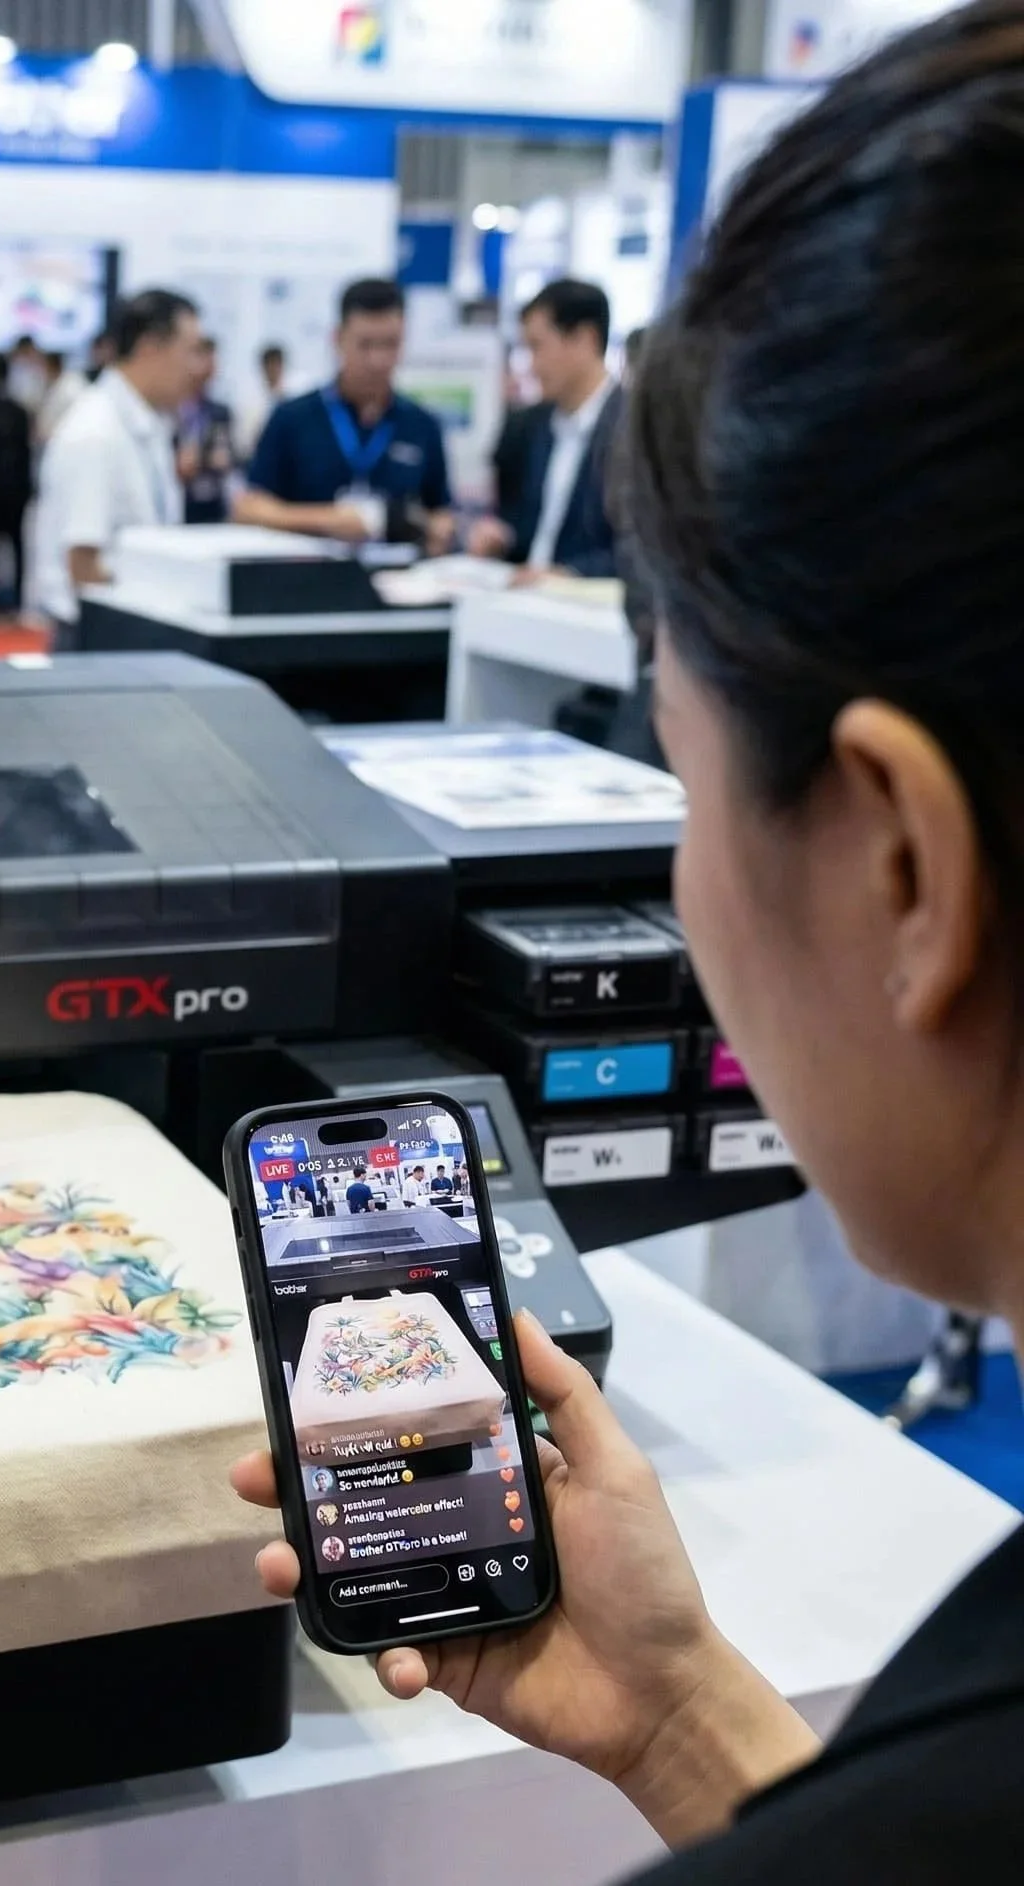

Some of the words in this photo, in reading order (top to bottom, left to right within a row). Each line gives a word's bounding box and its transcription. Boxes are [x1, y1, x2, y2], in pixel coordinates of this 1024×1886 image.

[46, 975, 170, 1022] GTX
[174, 986, 249, 1022] pro
[597, 971, 619, 999] K
[596, 1058, 618, 1085] C
[266, 1165, 289, 1177] LIVE
[339, 1585, 357, 1598] Add
